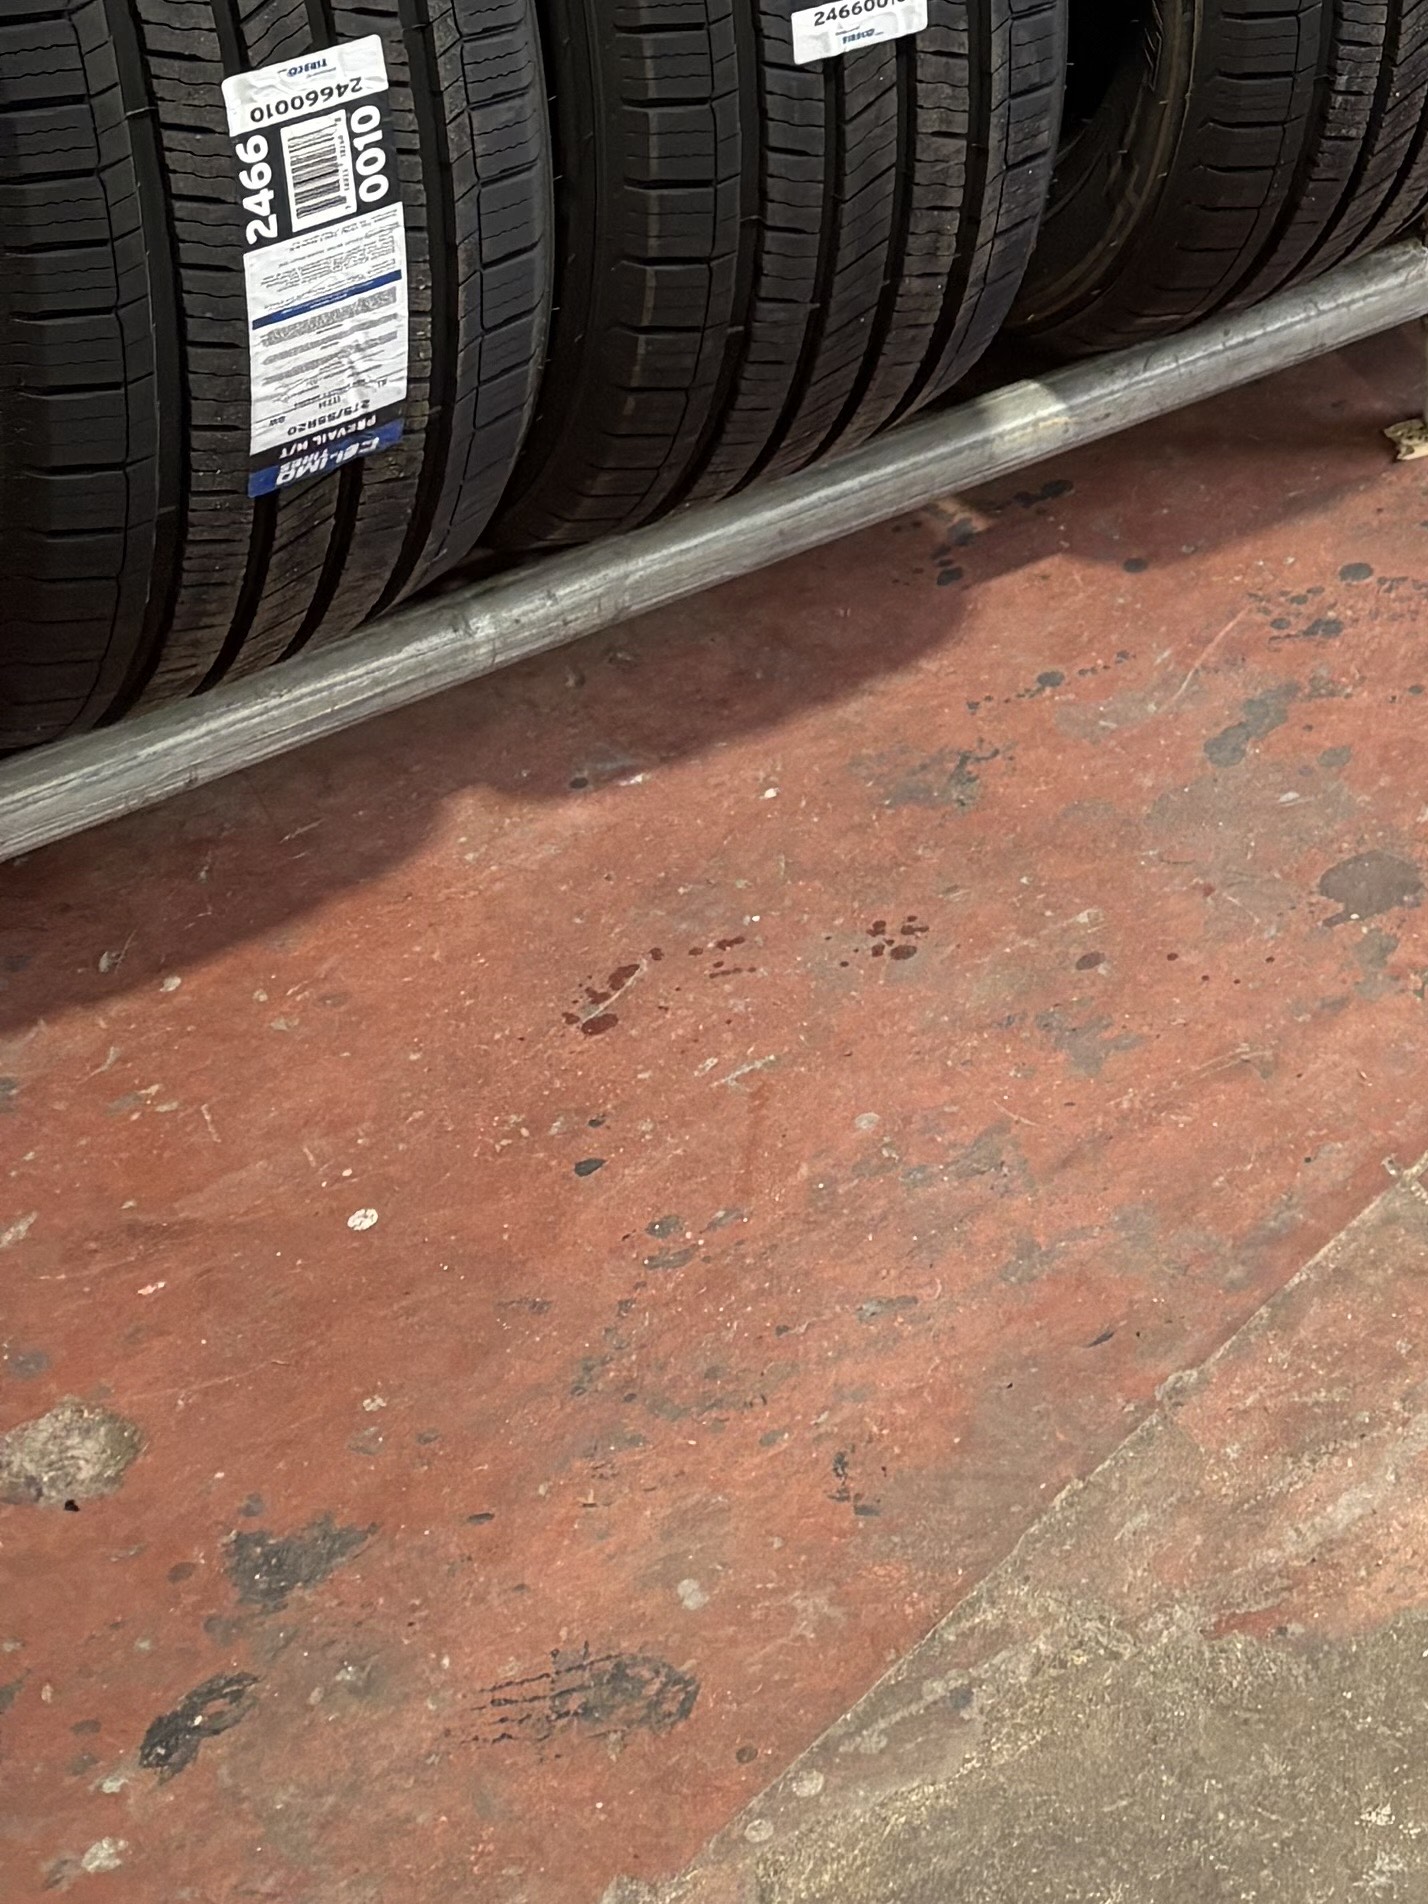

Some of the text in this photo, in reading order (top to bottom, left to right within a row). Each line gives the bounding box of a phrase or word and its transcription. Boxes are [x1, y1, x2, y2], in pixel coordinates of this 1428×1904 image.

[250, 76, 363, 123] 24660010
[236, 134, 276, 246] 2466
[351, 104, 390, 203] 0010
[313, 414, 377, 443] PREVAIL
